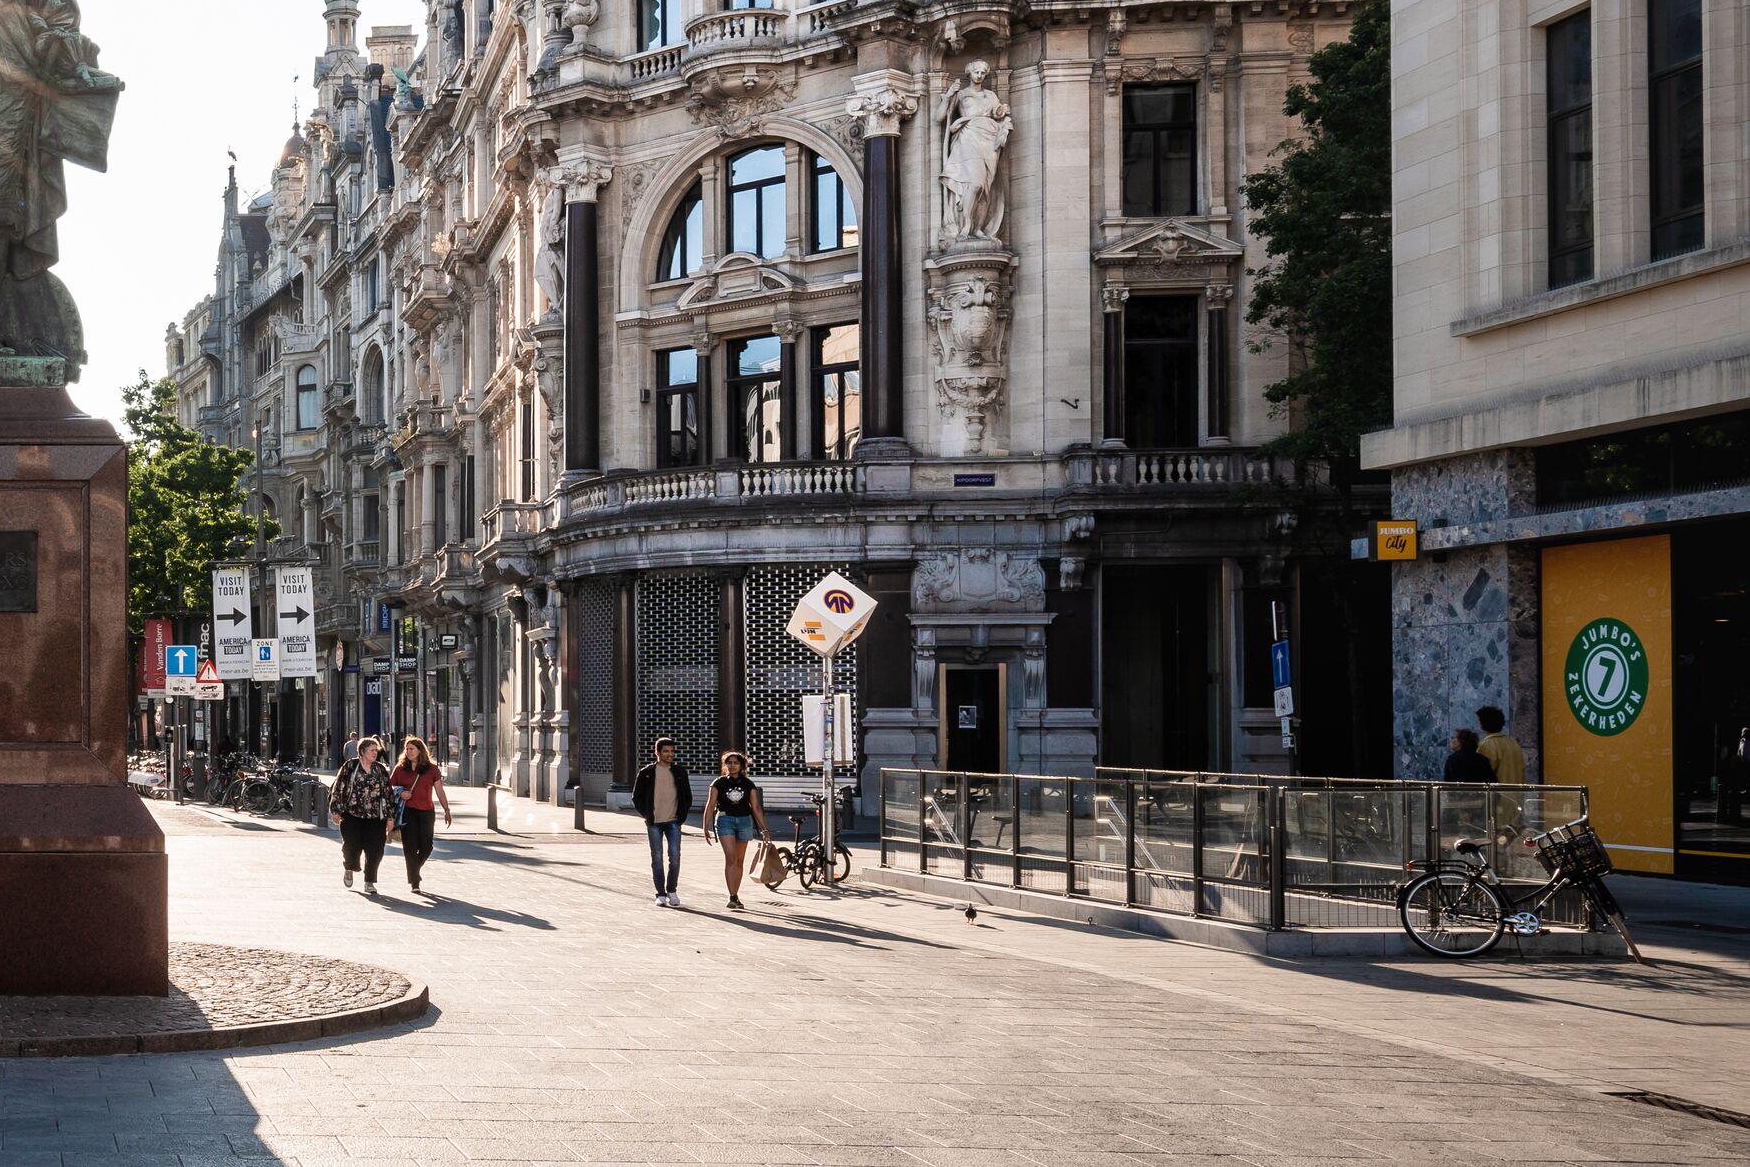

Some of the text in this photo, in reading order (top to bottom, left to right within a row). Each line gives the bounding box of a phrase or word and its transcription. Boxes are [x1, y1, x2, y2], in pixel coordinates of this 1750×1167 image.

[1379, 527, 1414, 535] JUMBO
[1386, 535, 1407, 553] city
[220, 577, 242, 586] VISIT
[283, 575, 305, 584] VISIT
[218, 587, 244, 596] TODAY
[281, 585, 307, 594] TODAY
[155, 624, 163, 643] Borre
[198, 623, 210, 659] fnac
[1581, 624, 1641, 661] JUMBO'S
[225, 647, 243, 655] TODAY
[288, 644, 306, 652] TODAY
[1598, 656, 1617, 698] 7
[1568, 672, 1642, 730] ZEKERHEDEN
